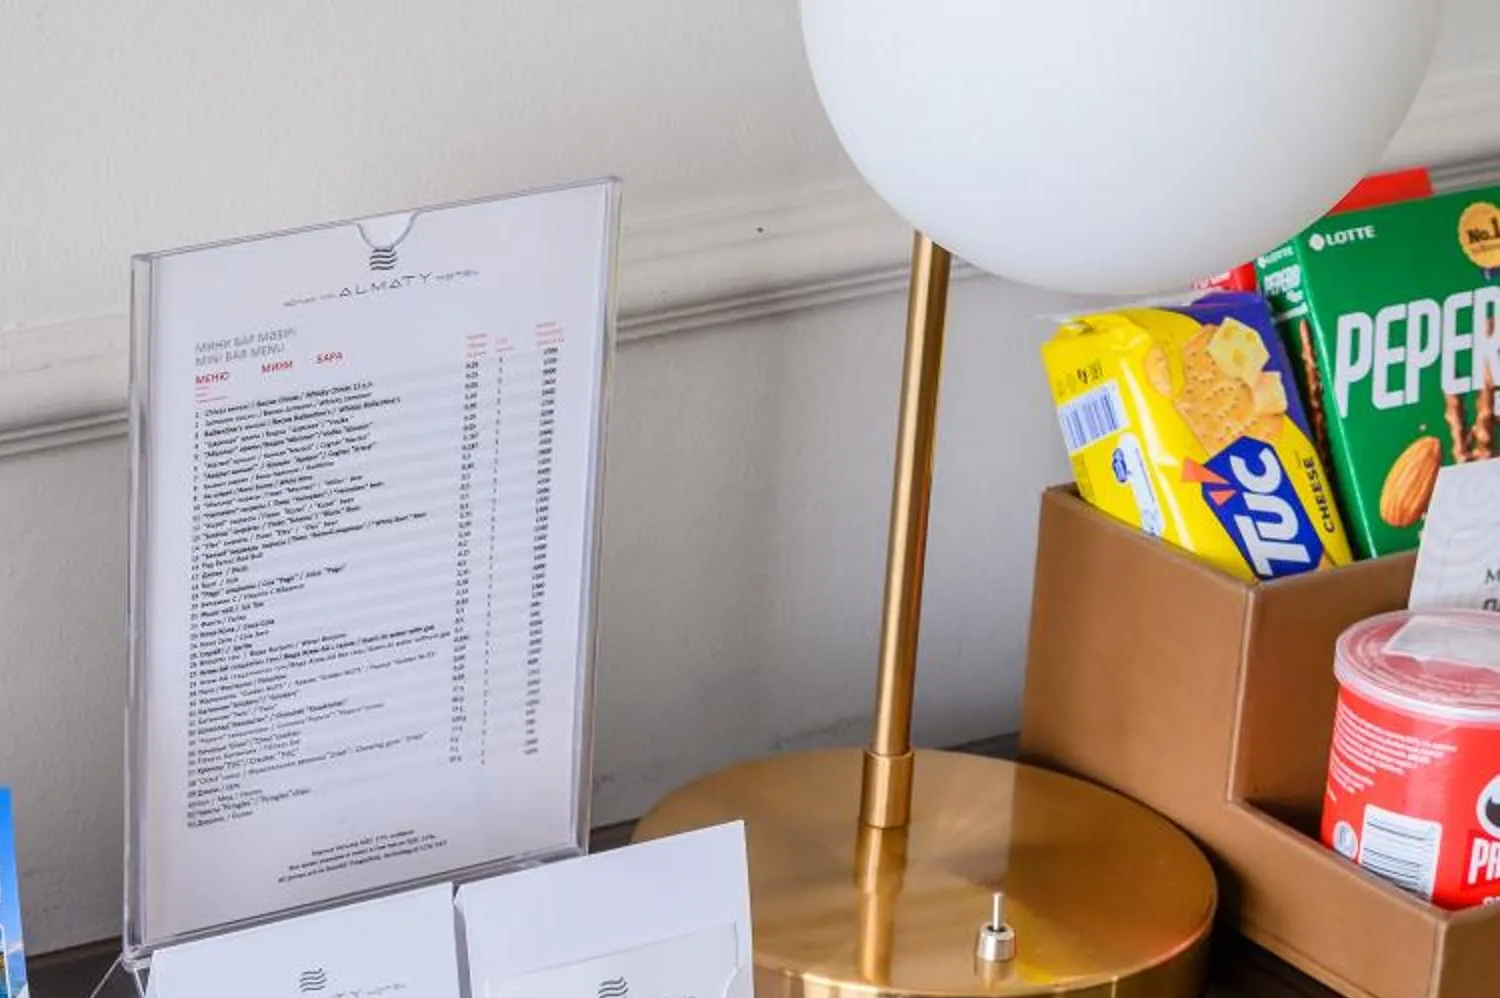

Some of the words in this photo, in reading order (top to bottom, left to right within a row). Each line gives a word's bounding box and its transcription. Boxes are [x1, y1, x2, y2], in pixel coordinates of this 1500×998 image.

[1325, 225, 1376, 245] LOTTE
[339, 272, 432, 297] ALMATY
[1229, 447, 1311, 576] TUC
[1302, 456, 1335, 533] CHEESE
